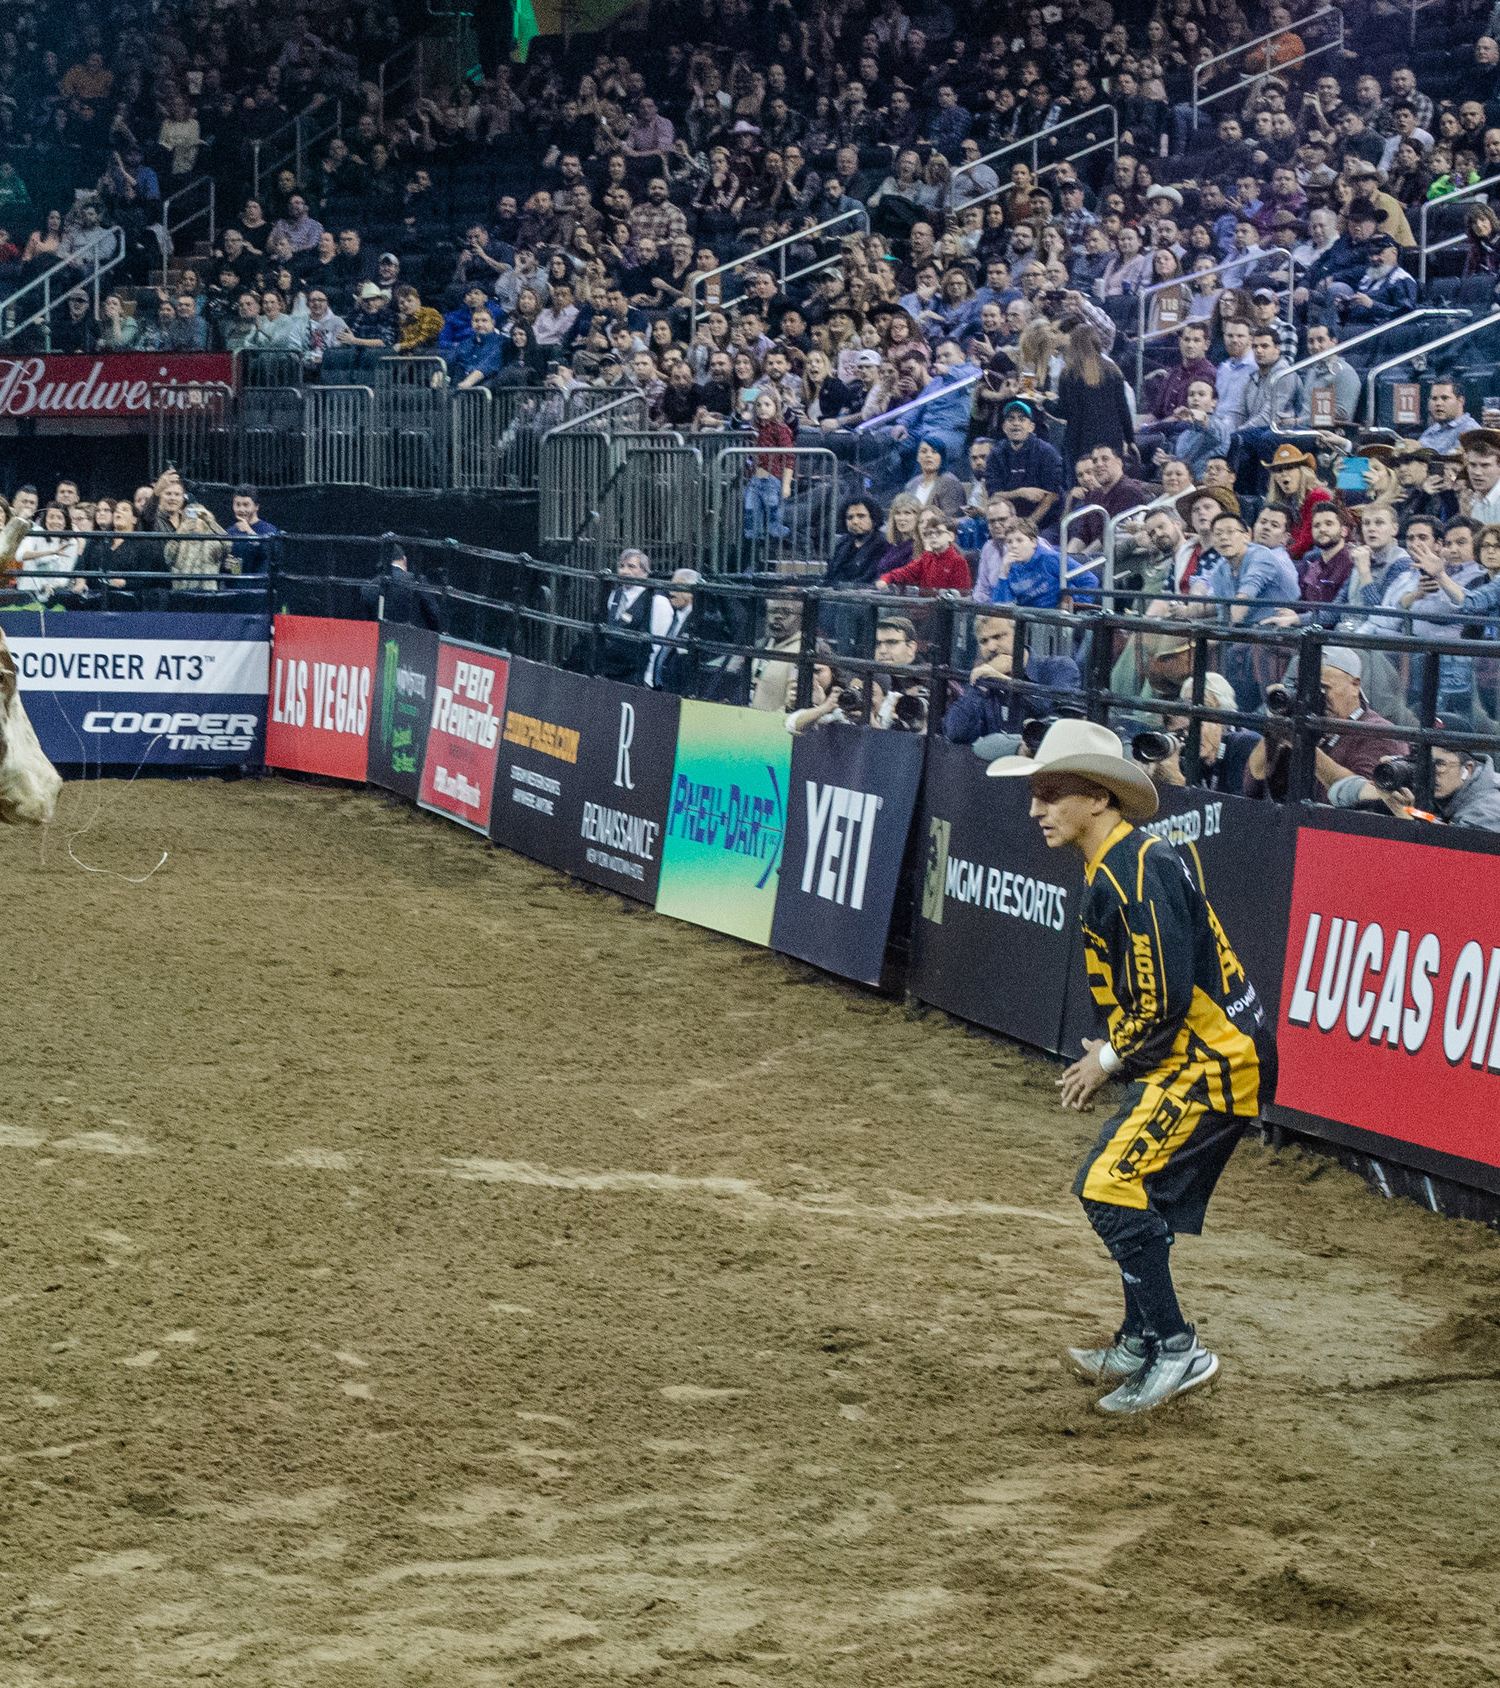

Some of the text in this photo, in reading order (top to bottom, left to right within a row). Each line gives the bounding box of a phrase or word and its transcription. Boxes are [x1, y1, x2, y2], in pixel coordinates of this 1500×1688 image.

[273, 658, 308, 728] LAS
[313, 661, 371, 737] VEGAS
[454, 660, 495, 704] PBR
[82, 711, 258, 735] COOPER
[165, 734, 255, 751] TIRES
[431, 685, 500, 749] Rewards
[613, 701, 636, 790] R
[801, 780, 878, 910] YETI
[1204, 802, 1222, 836] BY
[945, 856, 1067, 931] MGM RESORTS
[1288, 912, 1441, 1055] LUCAS
